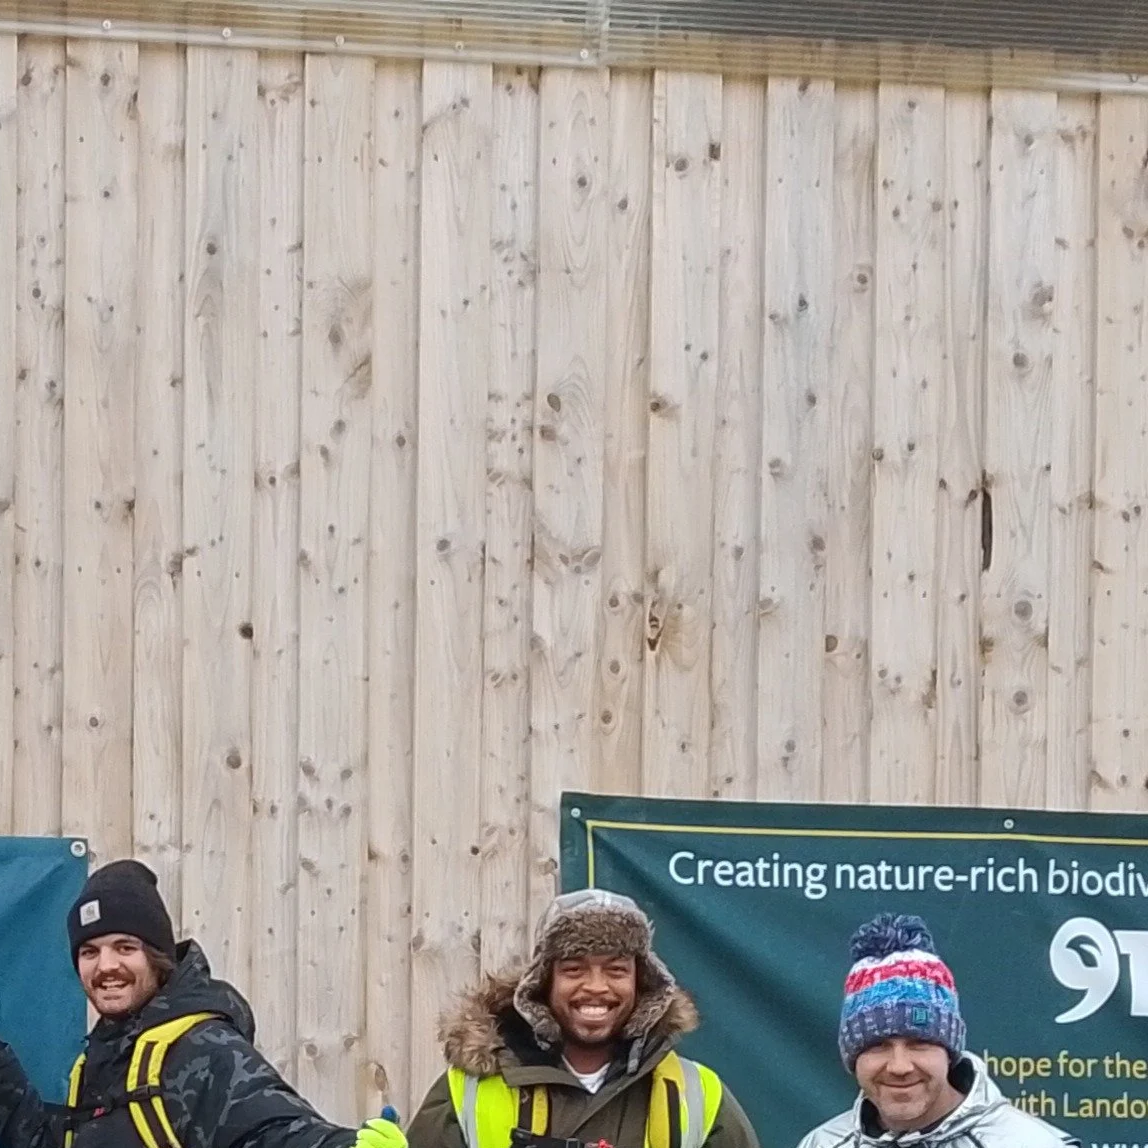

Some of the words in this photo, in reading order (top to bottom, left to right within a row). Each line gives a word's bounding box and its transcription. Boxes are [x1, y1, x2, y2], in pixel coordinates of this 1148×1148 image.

[668, 851, 828, 900] Creating
[835, 857, 1038, 893] nature-rich
[983, 1049, 1052, 1084] hope
[1056, 1050, 1099, 1078] for
[1103, 1051, 1148, 1079] the
[1063, 1092, 1148, 1119] Lando
